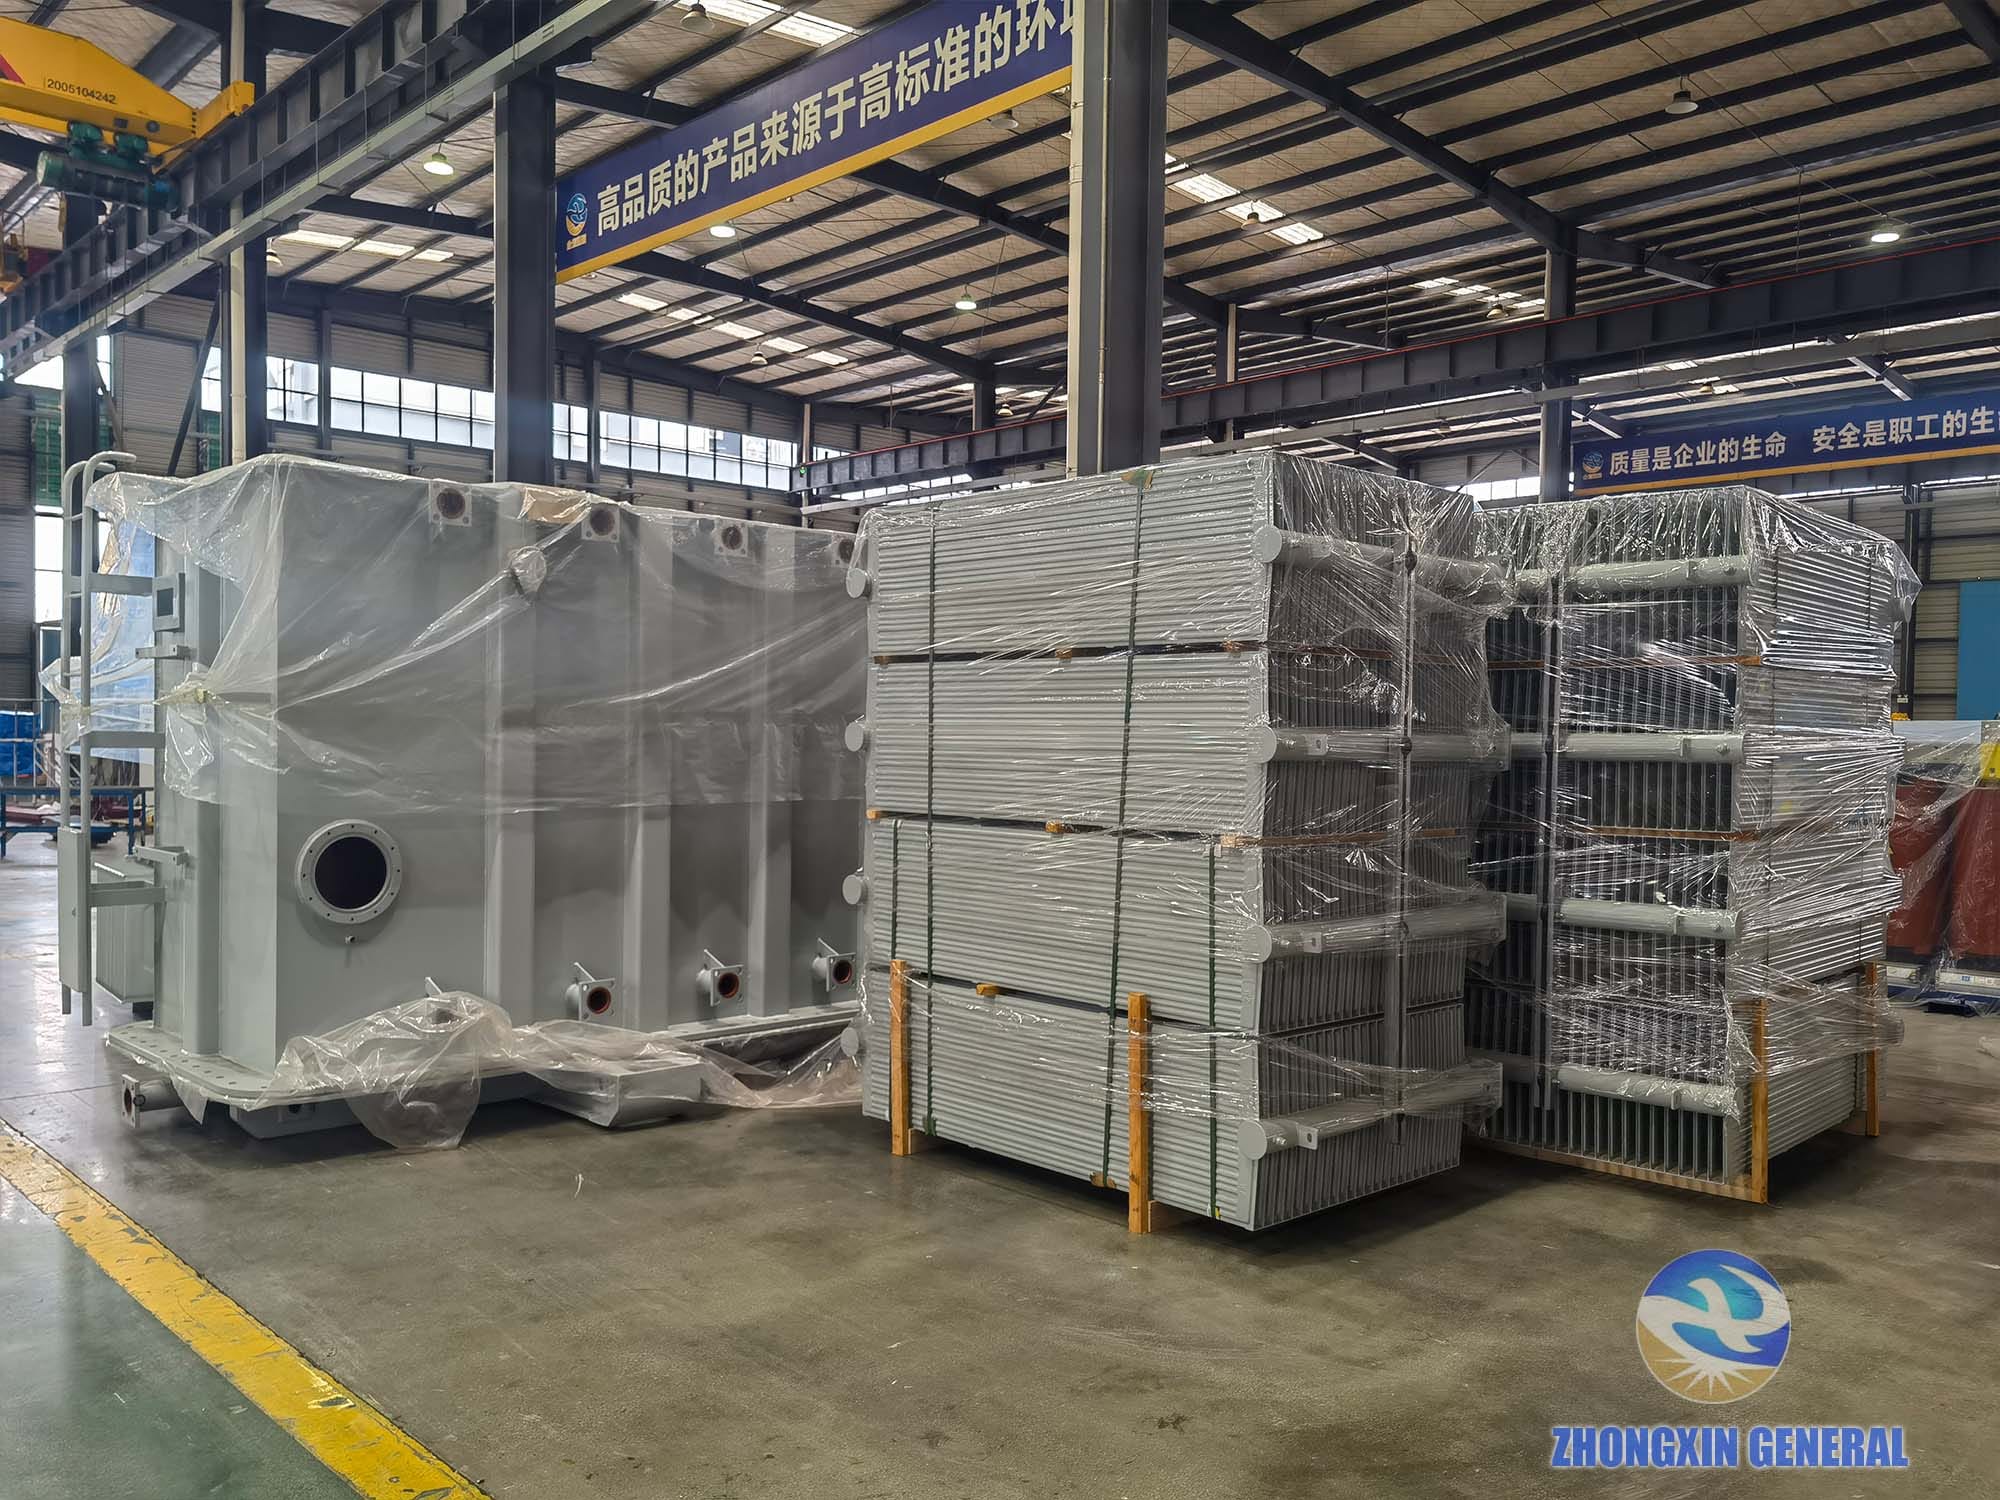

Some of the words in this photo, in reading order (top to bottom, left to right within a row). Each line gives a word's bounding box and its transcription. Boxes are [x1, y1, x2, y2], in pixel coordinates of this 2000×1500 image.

[47, 78, 117, 105] 2005104242
[1609, 431, 1787, 476] 质量是企业的生命
[1812, 405, 2000, 453] 安全是职工的生
